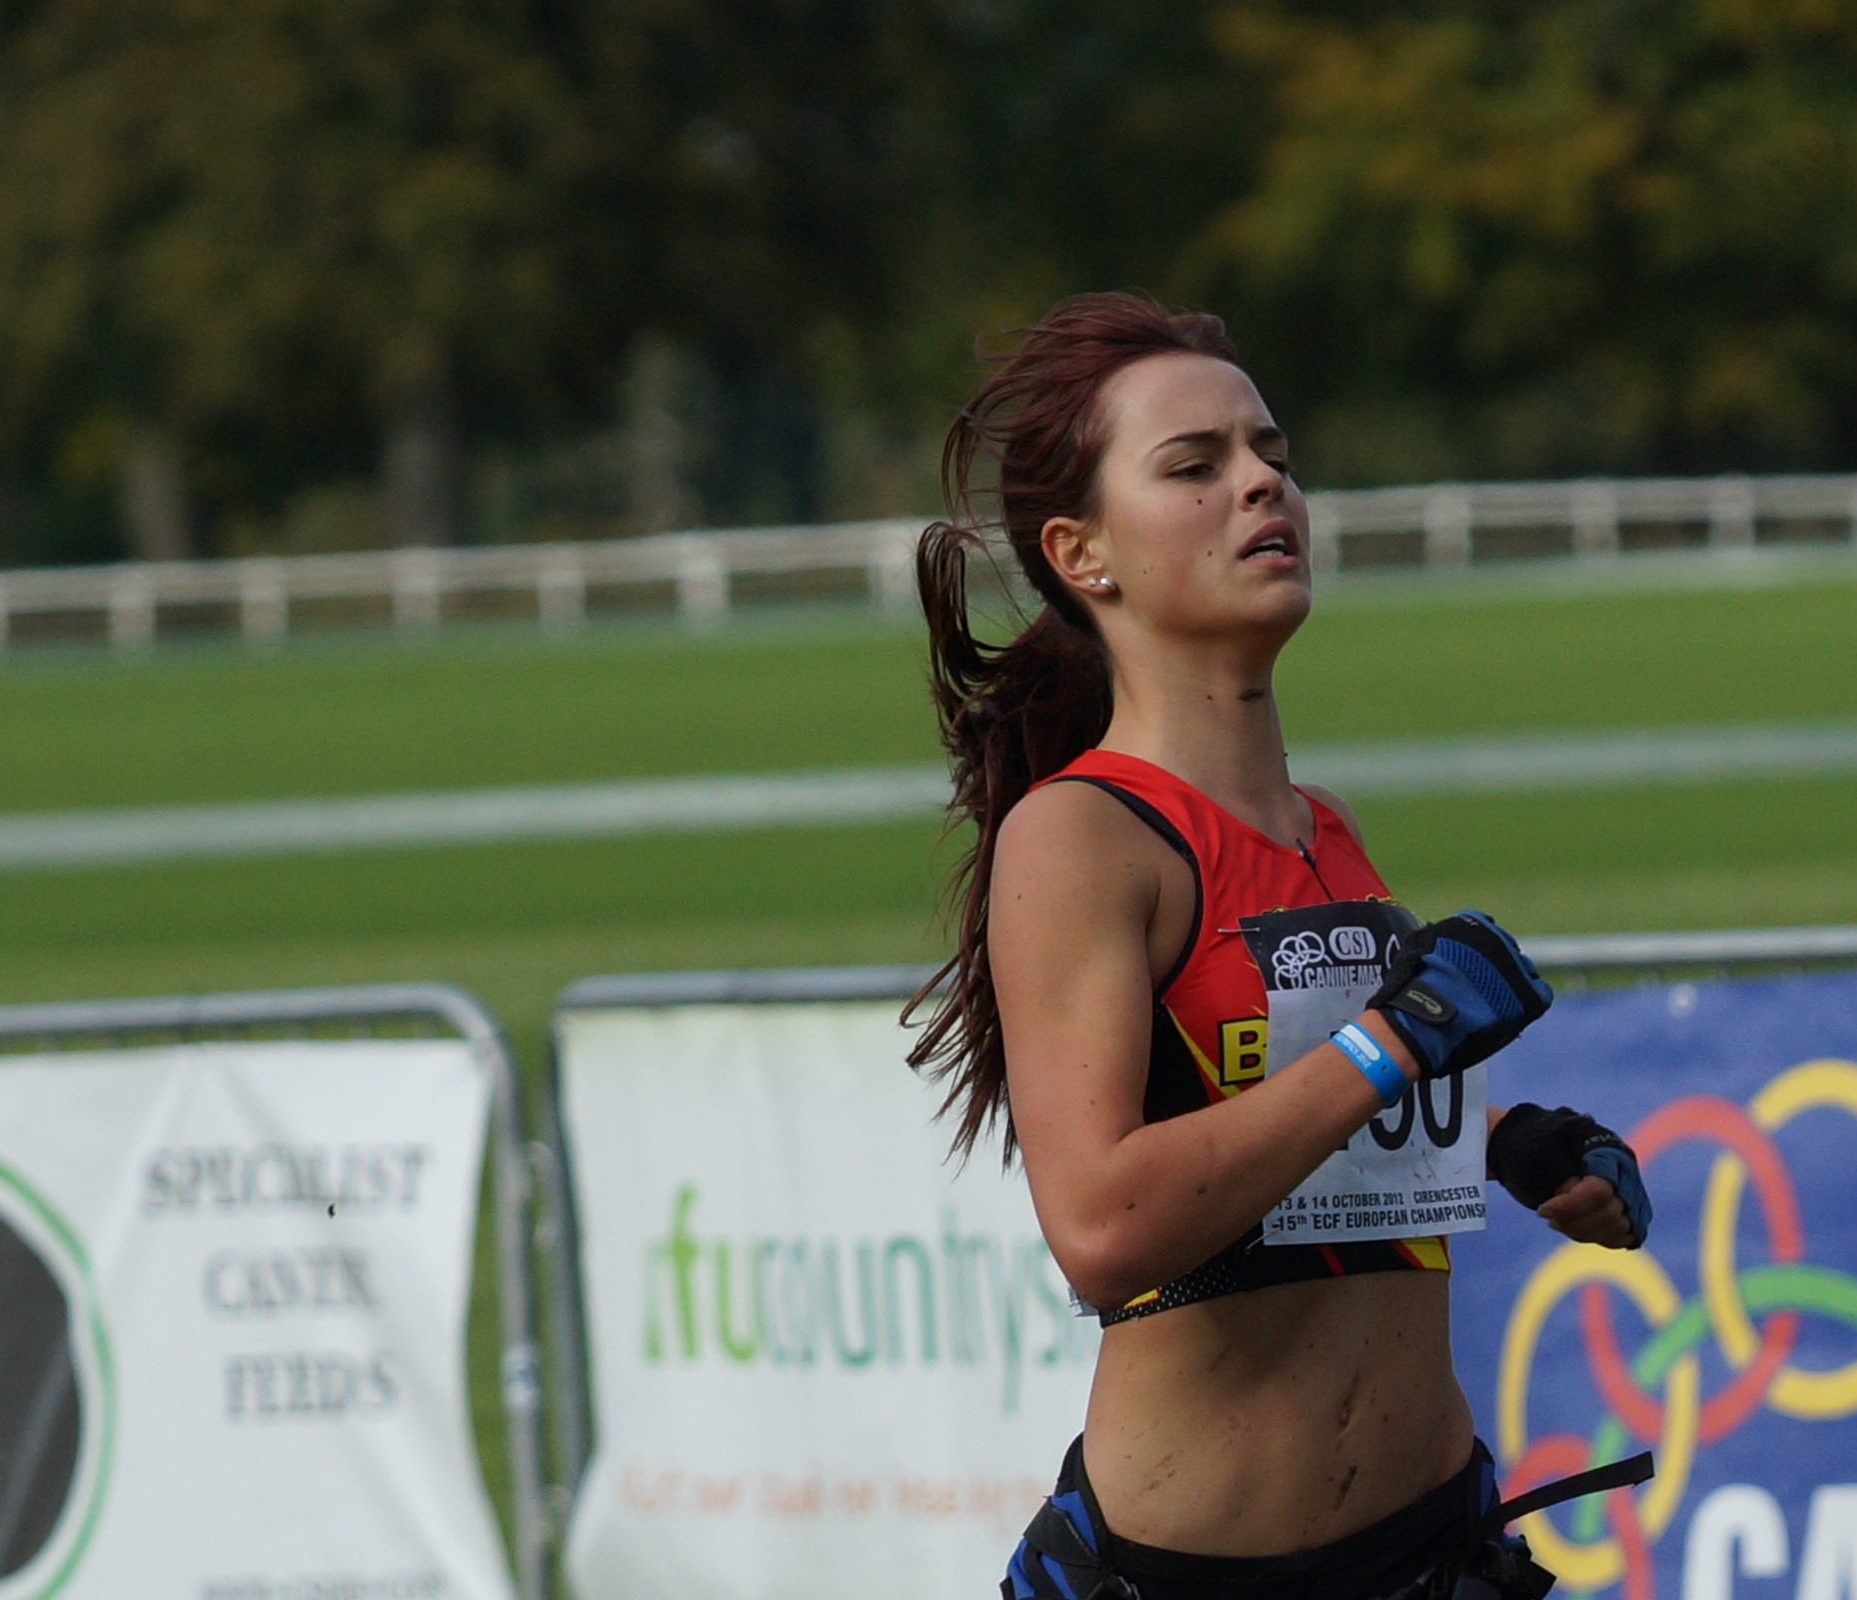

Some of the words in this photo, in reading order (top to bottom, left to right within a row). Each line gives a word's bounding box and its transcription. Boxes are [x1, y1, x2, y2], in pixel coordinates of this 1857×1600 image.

[1335, 930, 1371, 958] CSJ
[1297, 1195, 1307, 1210] &
[1312, 1195, 1328, 1209] 14
[1332, 1193, 1381, 1209] OCTOBER
[1383, 1192, 1404, 1206] 2012
[1413, 1185, 1480, 1204] CIRENCESTER
[1313, 1212, 1341, 1230] ECF
[1346, 1208, 1409, 1228] EUROPEAN
